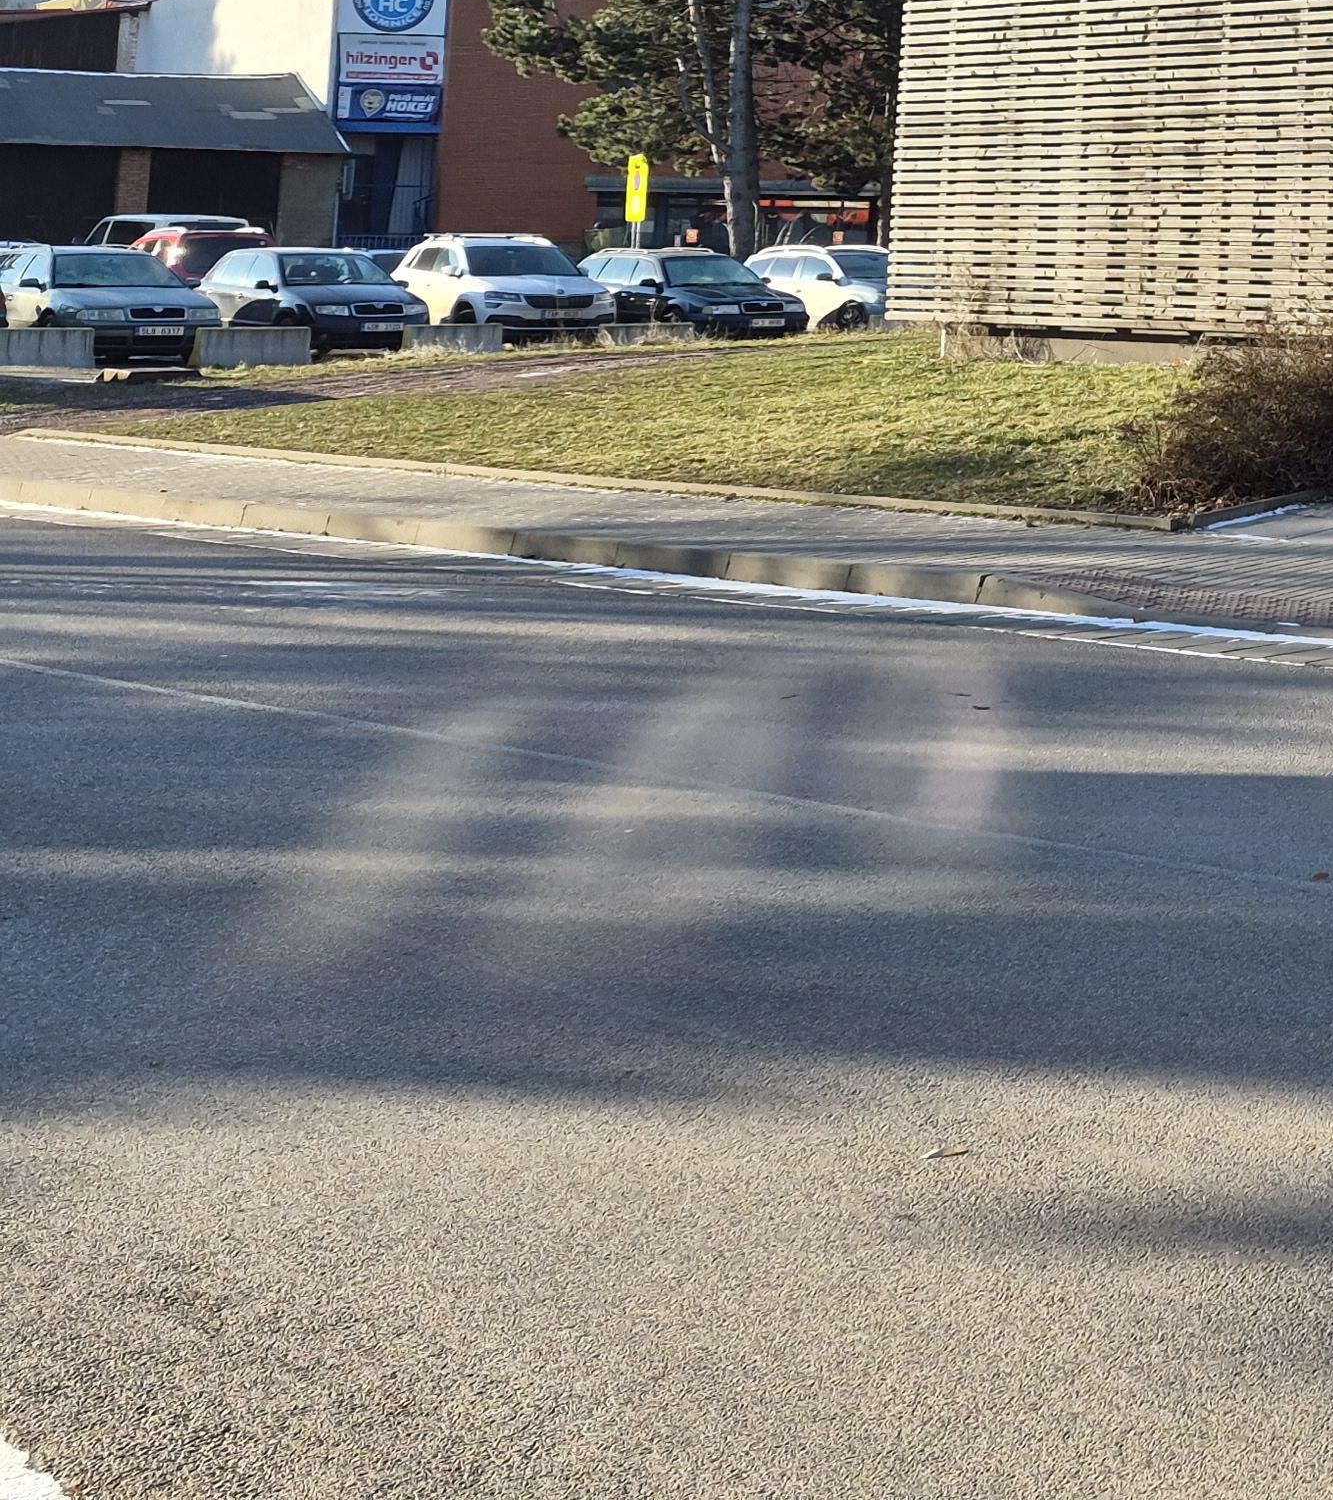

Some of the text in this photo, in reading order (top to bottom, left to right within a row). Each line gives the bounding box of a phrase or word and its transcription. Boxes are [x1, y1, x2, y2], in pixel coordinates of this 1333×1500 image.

[363, 4, 422, 28] LOMNICE
[346, 51, 417, 69] hilzinger
[385, 101, 434, 113] HOKEJ
